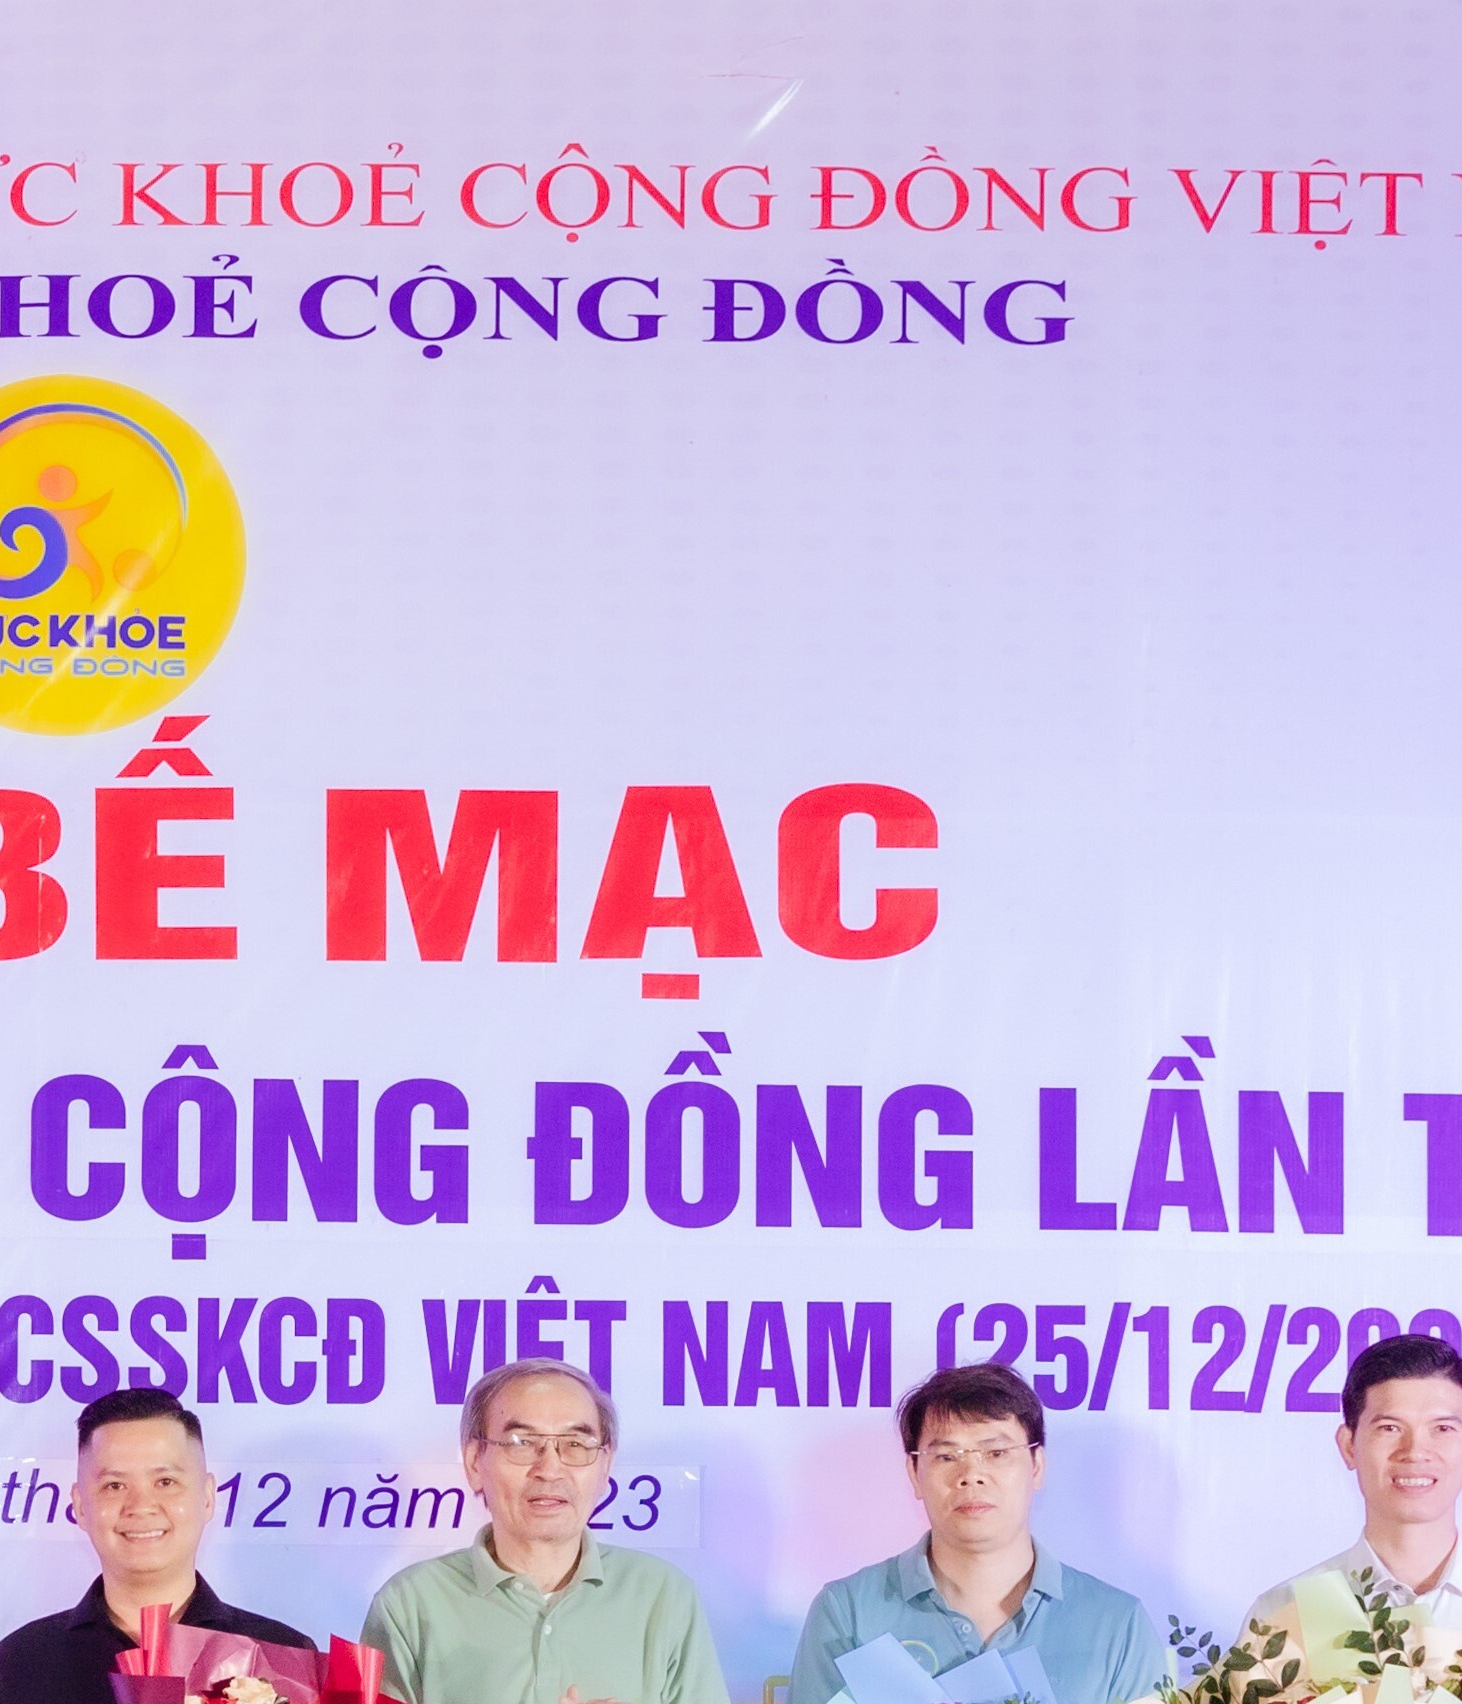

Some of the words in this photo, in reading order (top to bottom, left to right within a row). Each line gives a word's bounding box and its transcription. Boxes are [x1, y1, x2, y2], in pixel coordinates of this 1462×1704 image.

[113, 143, 425, 229] KHOẺ
[460, 143, 778, 243] CỘNG
[810, 146, 1138, 233] ĐỒNG
[1168, 158, 1424, 250] VIỆT
[299, 264, 668, 359] CỘNG
[702, 257, 1075, 346] ĐỒNG
[326, 783, 939, 1000] MẠC
[30, 1044, 470, 1260] CỘNG
[526, 1031, 975, 1231] ĐỒNG
[1038, 1035, 1345, 1235] LẦN
[662, 1299, 894, 1408] NAM
[216, 1472, 292, 1529] 12
[317, 1473, 466, 1530] năm
